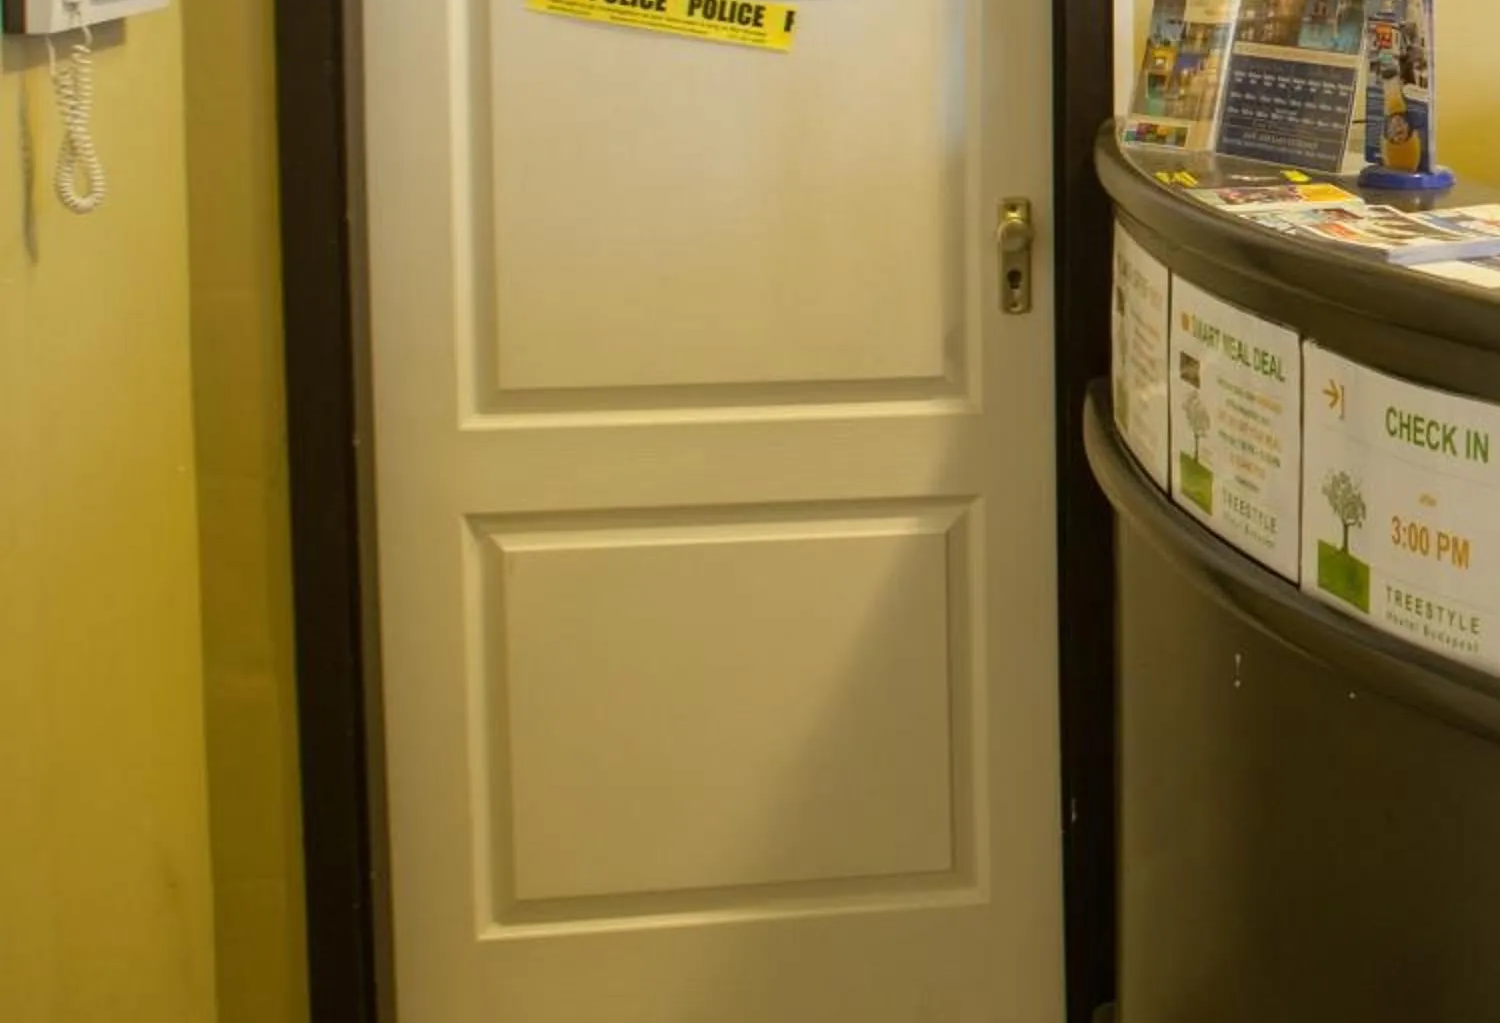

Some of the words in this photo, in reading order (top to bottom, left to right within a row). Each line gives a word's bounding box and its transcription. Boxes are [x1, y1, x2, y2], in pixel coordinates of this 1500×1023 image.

[1223, 332, 1252, 368] MEAL
[1253, 348, 1286, 383] DEAL
[1385, 406, 1458, 457] CHECK
[1466, 429, 1490, 465] IN
[1391, 515, 1430, 556] 3:00
[1437, 531, 1470, 570] PM
[1386, 585, 1480, 634] TREESTYLE
